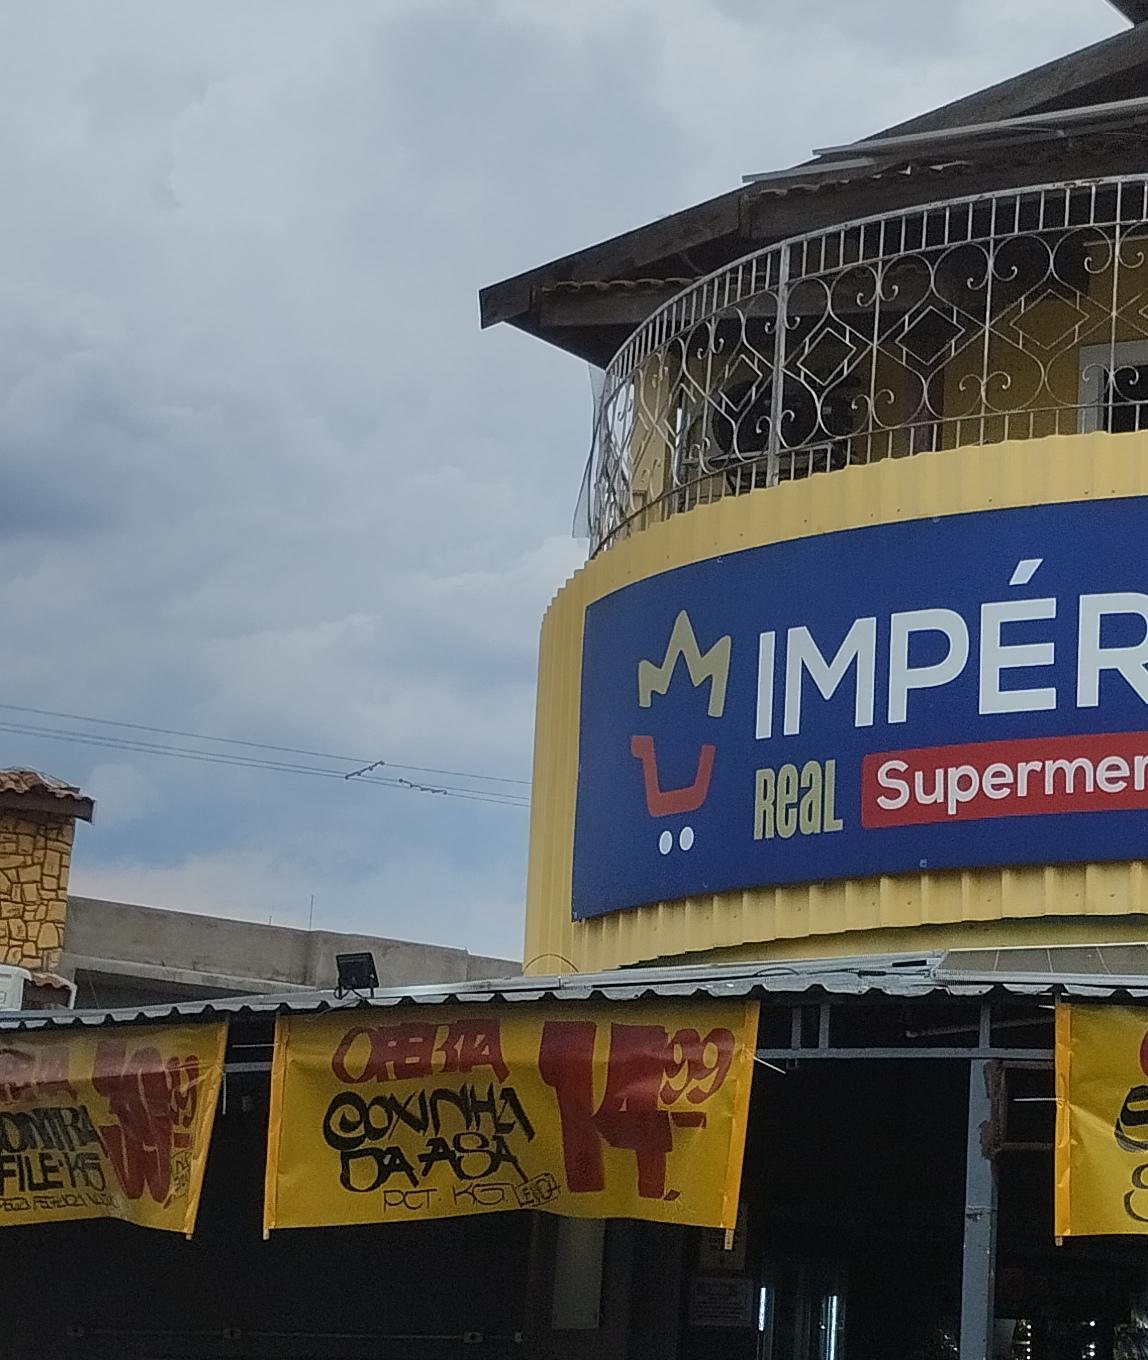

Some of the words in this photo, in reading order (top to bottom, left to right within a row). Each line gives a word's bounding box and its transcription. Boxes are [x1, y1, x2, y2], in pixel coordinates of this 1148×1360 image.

[323, 1083, 536, 1151] COXINHA
[340, 1146, 419, 1192] DA
[418, 1132, 530, 1183] ASA
